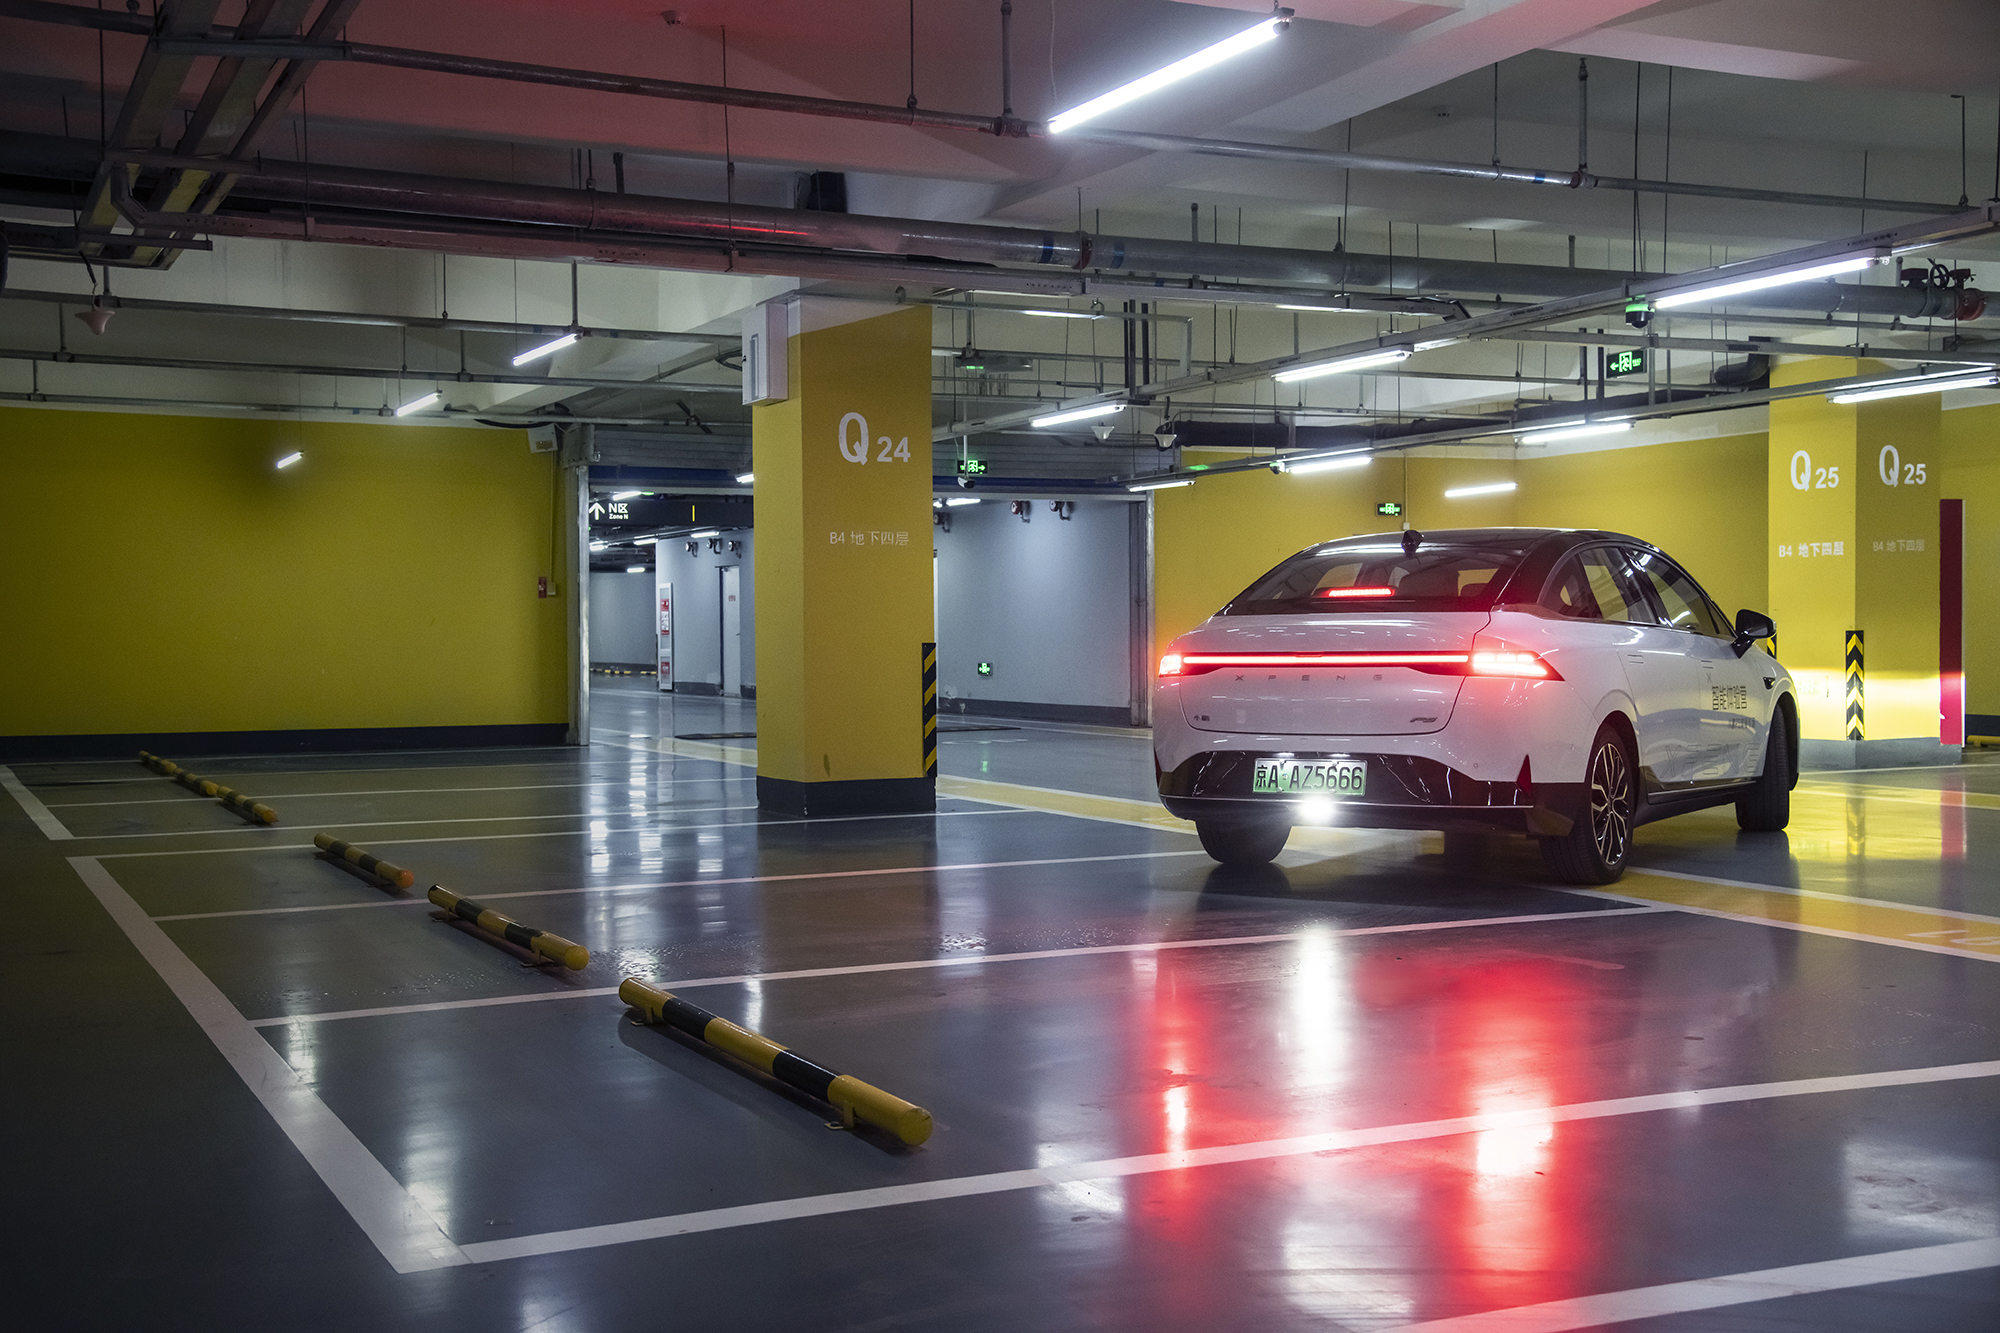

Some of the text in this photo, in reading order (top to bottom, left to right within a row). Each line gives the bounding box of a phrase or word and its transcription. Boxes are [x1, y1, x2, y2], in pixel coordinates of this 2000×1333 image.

[838, 412, 911, 466] Q 24
[1790, 450, 1840, 491] Q 25
[1879, 445, 1927, 487] Q 25
[830, 530, 909, 547] B4 地下四层
[1872, 539, 1925, 552] B4 地下四层
[1778, 541, 1845, 558] B4 地下四层
[1234, 674, 1383, 682] XPENG
[1289, 765, 1363, 791] AZ5666
